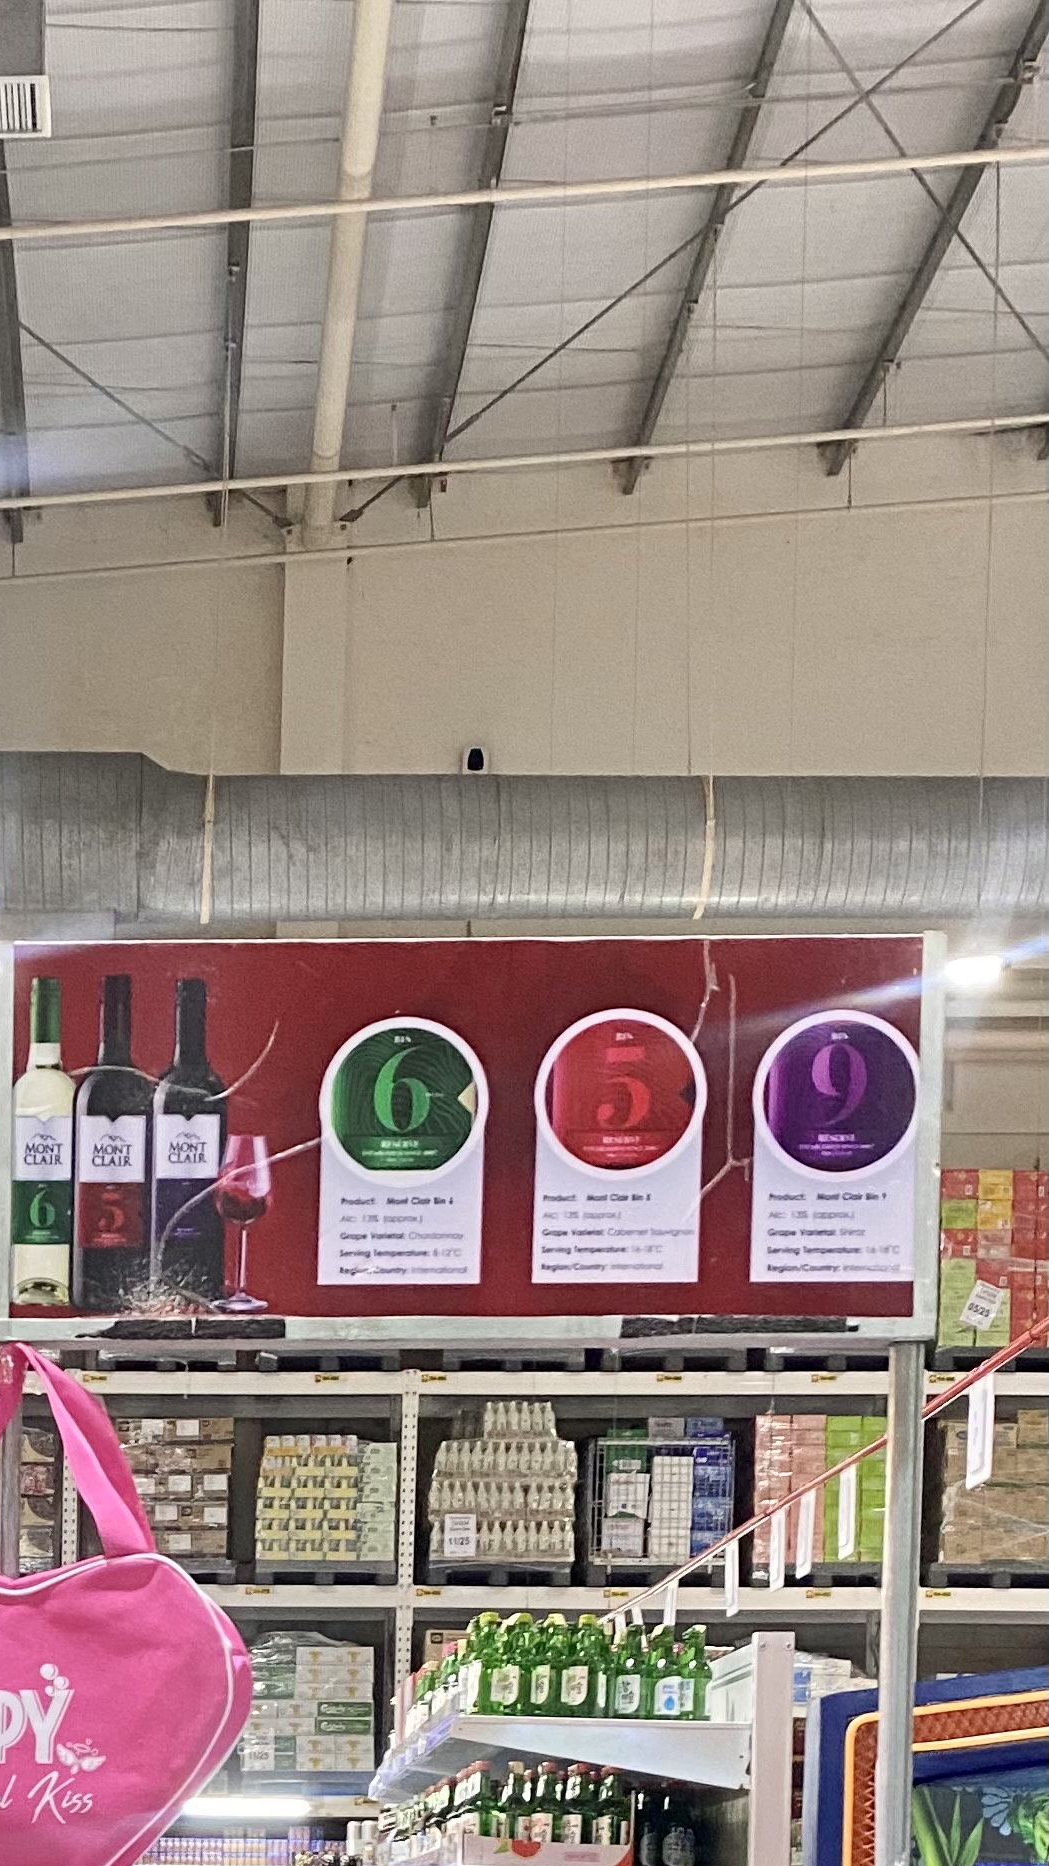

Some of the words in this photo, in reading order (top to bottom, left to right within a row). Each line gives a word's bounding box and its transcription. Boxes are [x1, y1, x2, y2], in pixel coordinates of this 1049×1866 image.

[374, 1045, 429, 1133] 6
[597, 1046, 651, 1129] 5
[812, 1043, 868, 1125] 9
[25, 1143, 63, 1155] MONT
[93, 1144, 132, 1156] MONT
[169, 1141, 207, 1153] MONT
[24, 1154, 63, 1166] CLAIR
[92, 1155, 132, 1167] CLAIR
[168, 1153, 207, 1164] CLAIR
[30, 1189, 55, 1228] 6
[27, 1770, 94, 1824] Kiss
